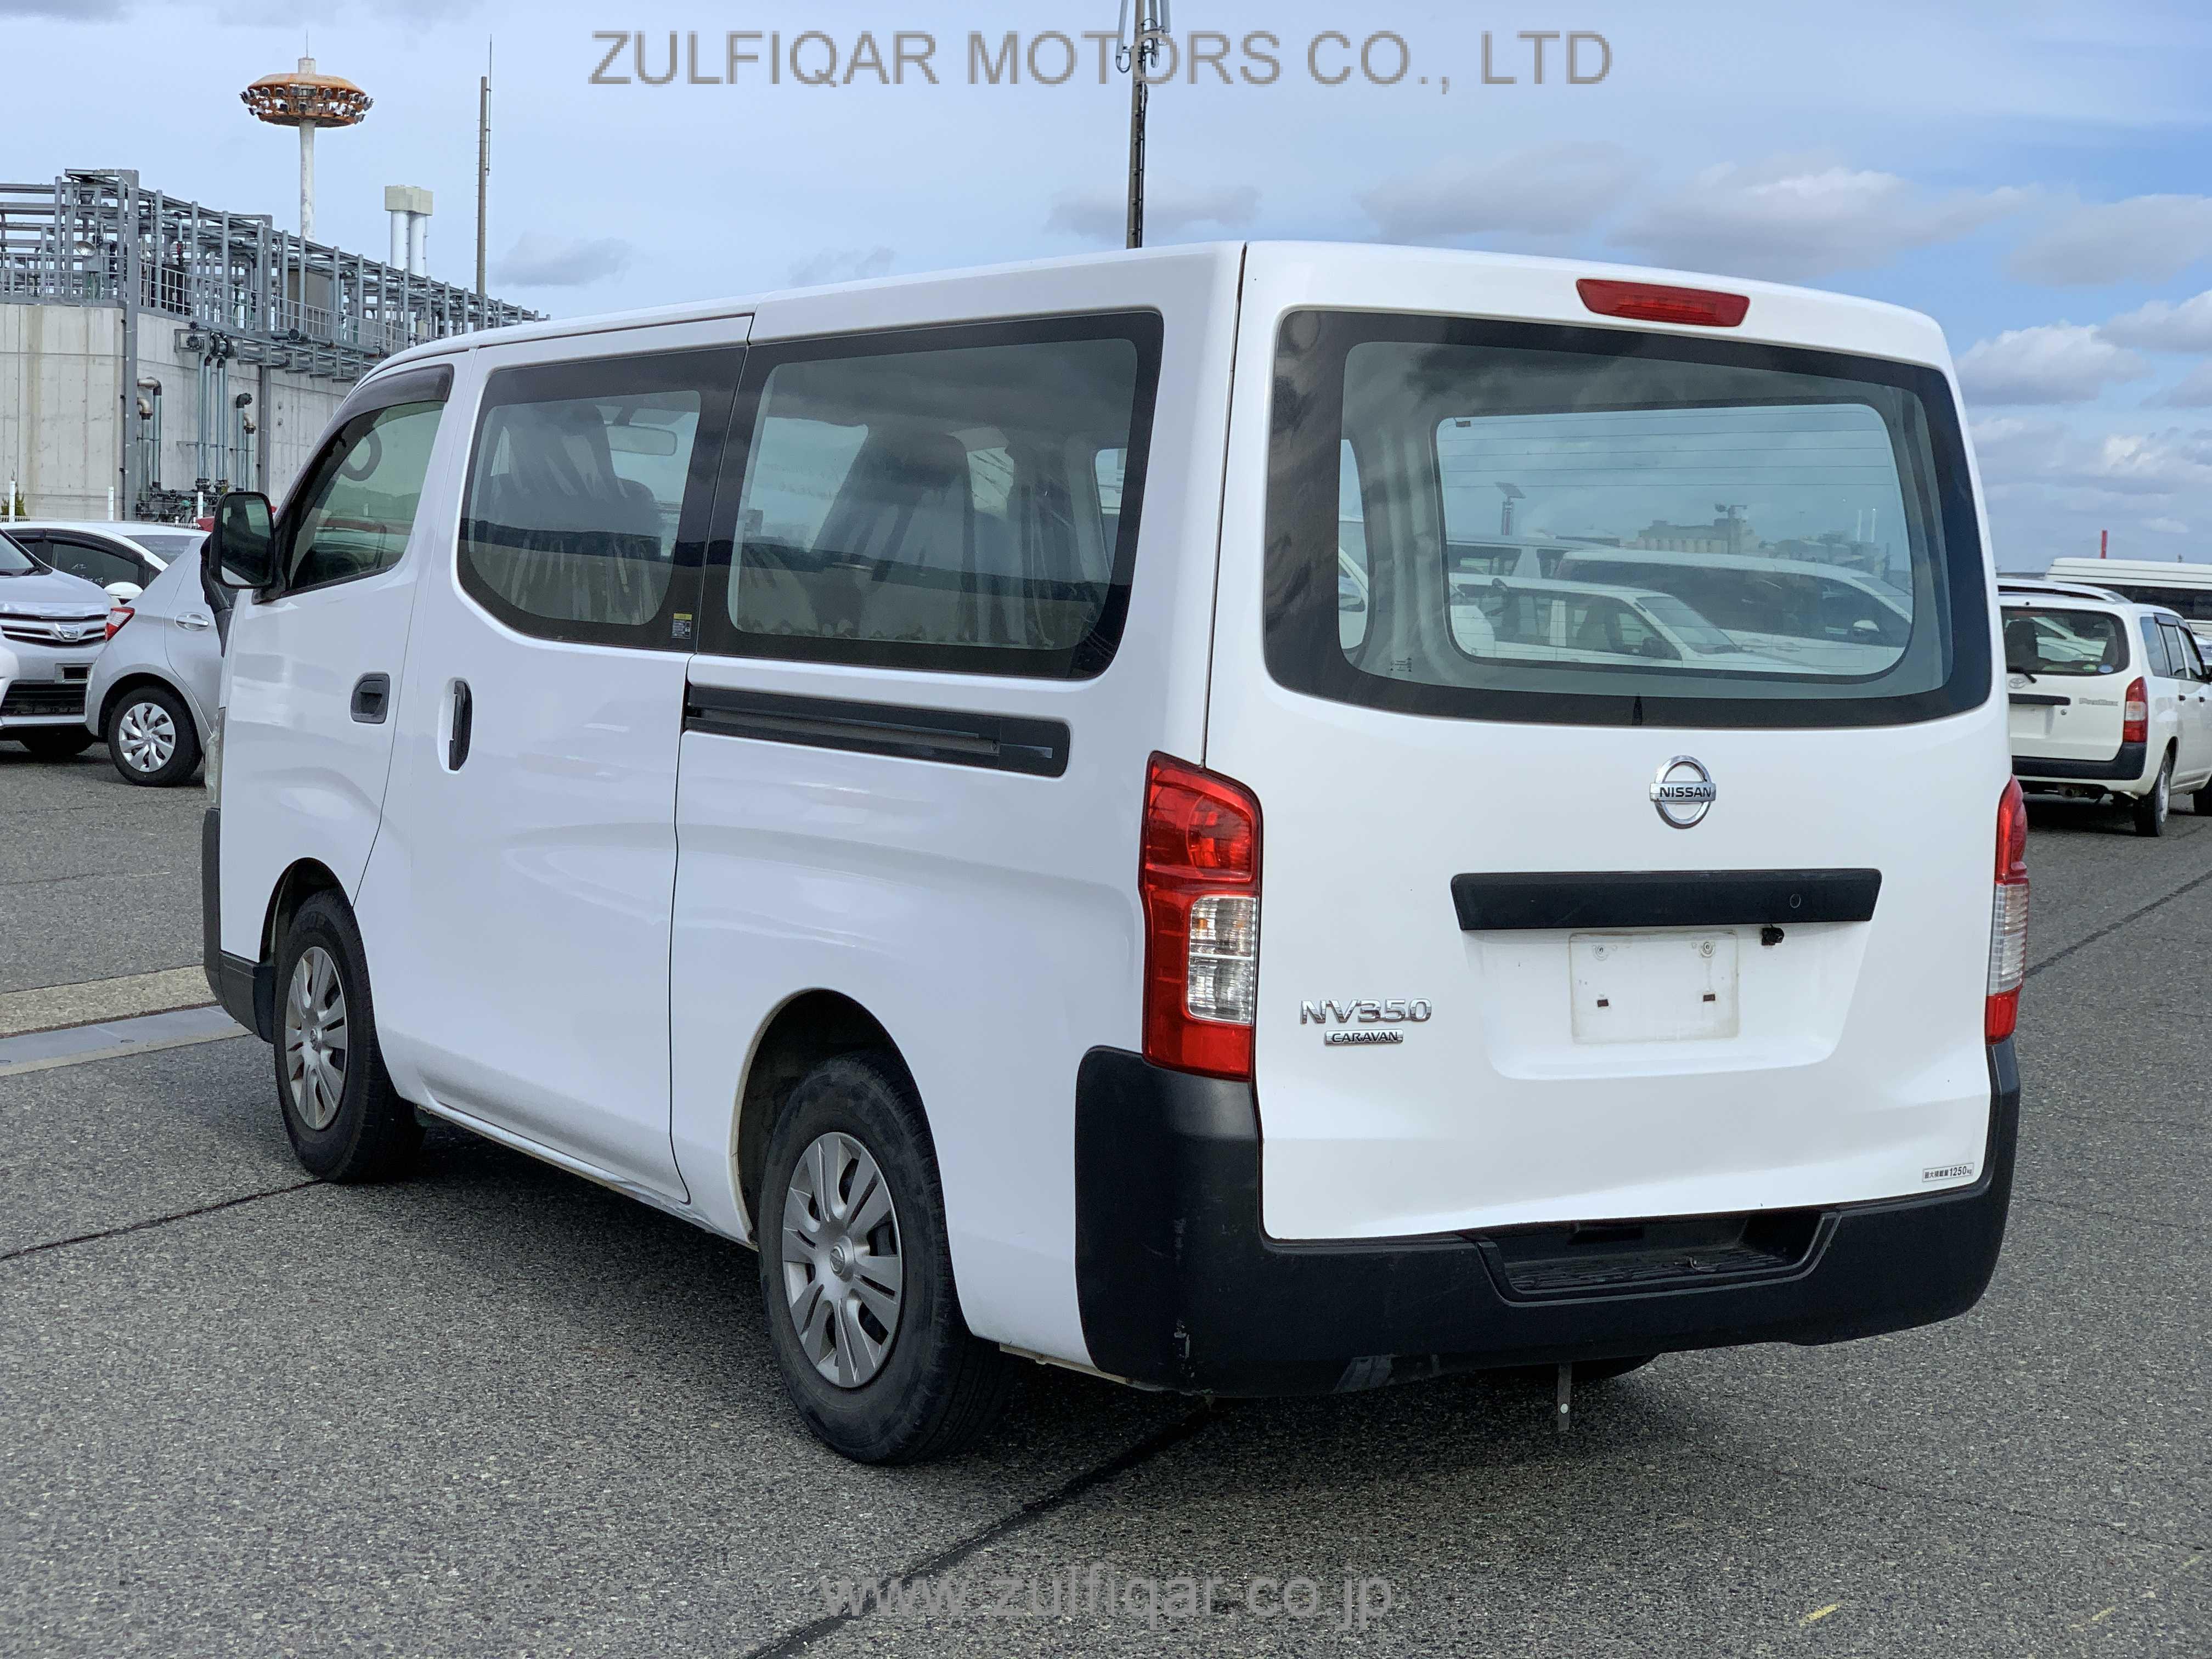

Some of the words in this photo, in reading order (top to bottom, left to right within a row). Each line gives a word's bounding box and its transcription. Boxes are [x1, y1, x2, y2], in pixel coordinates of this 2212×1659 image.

[1660, 787, 1711, 797] NISSAN
[1300, 998, 1432, 1024] NV350
[1331, 1031, 1398, 1043] CARAVAN
